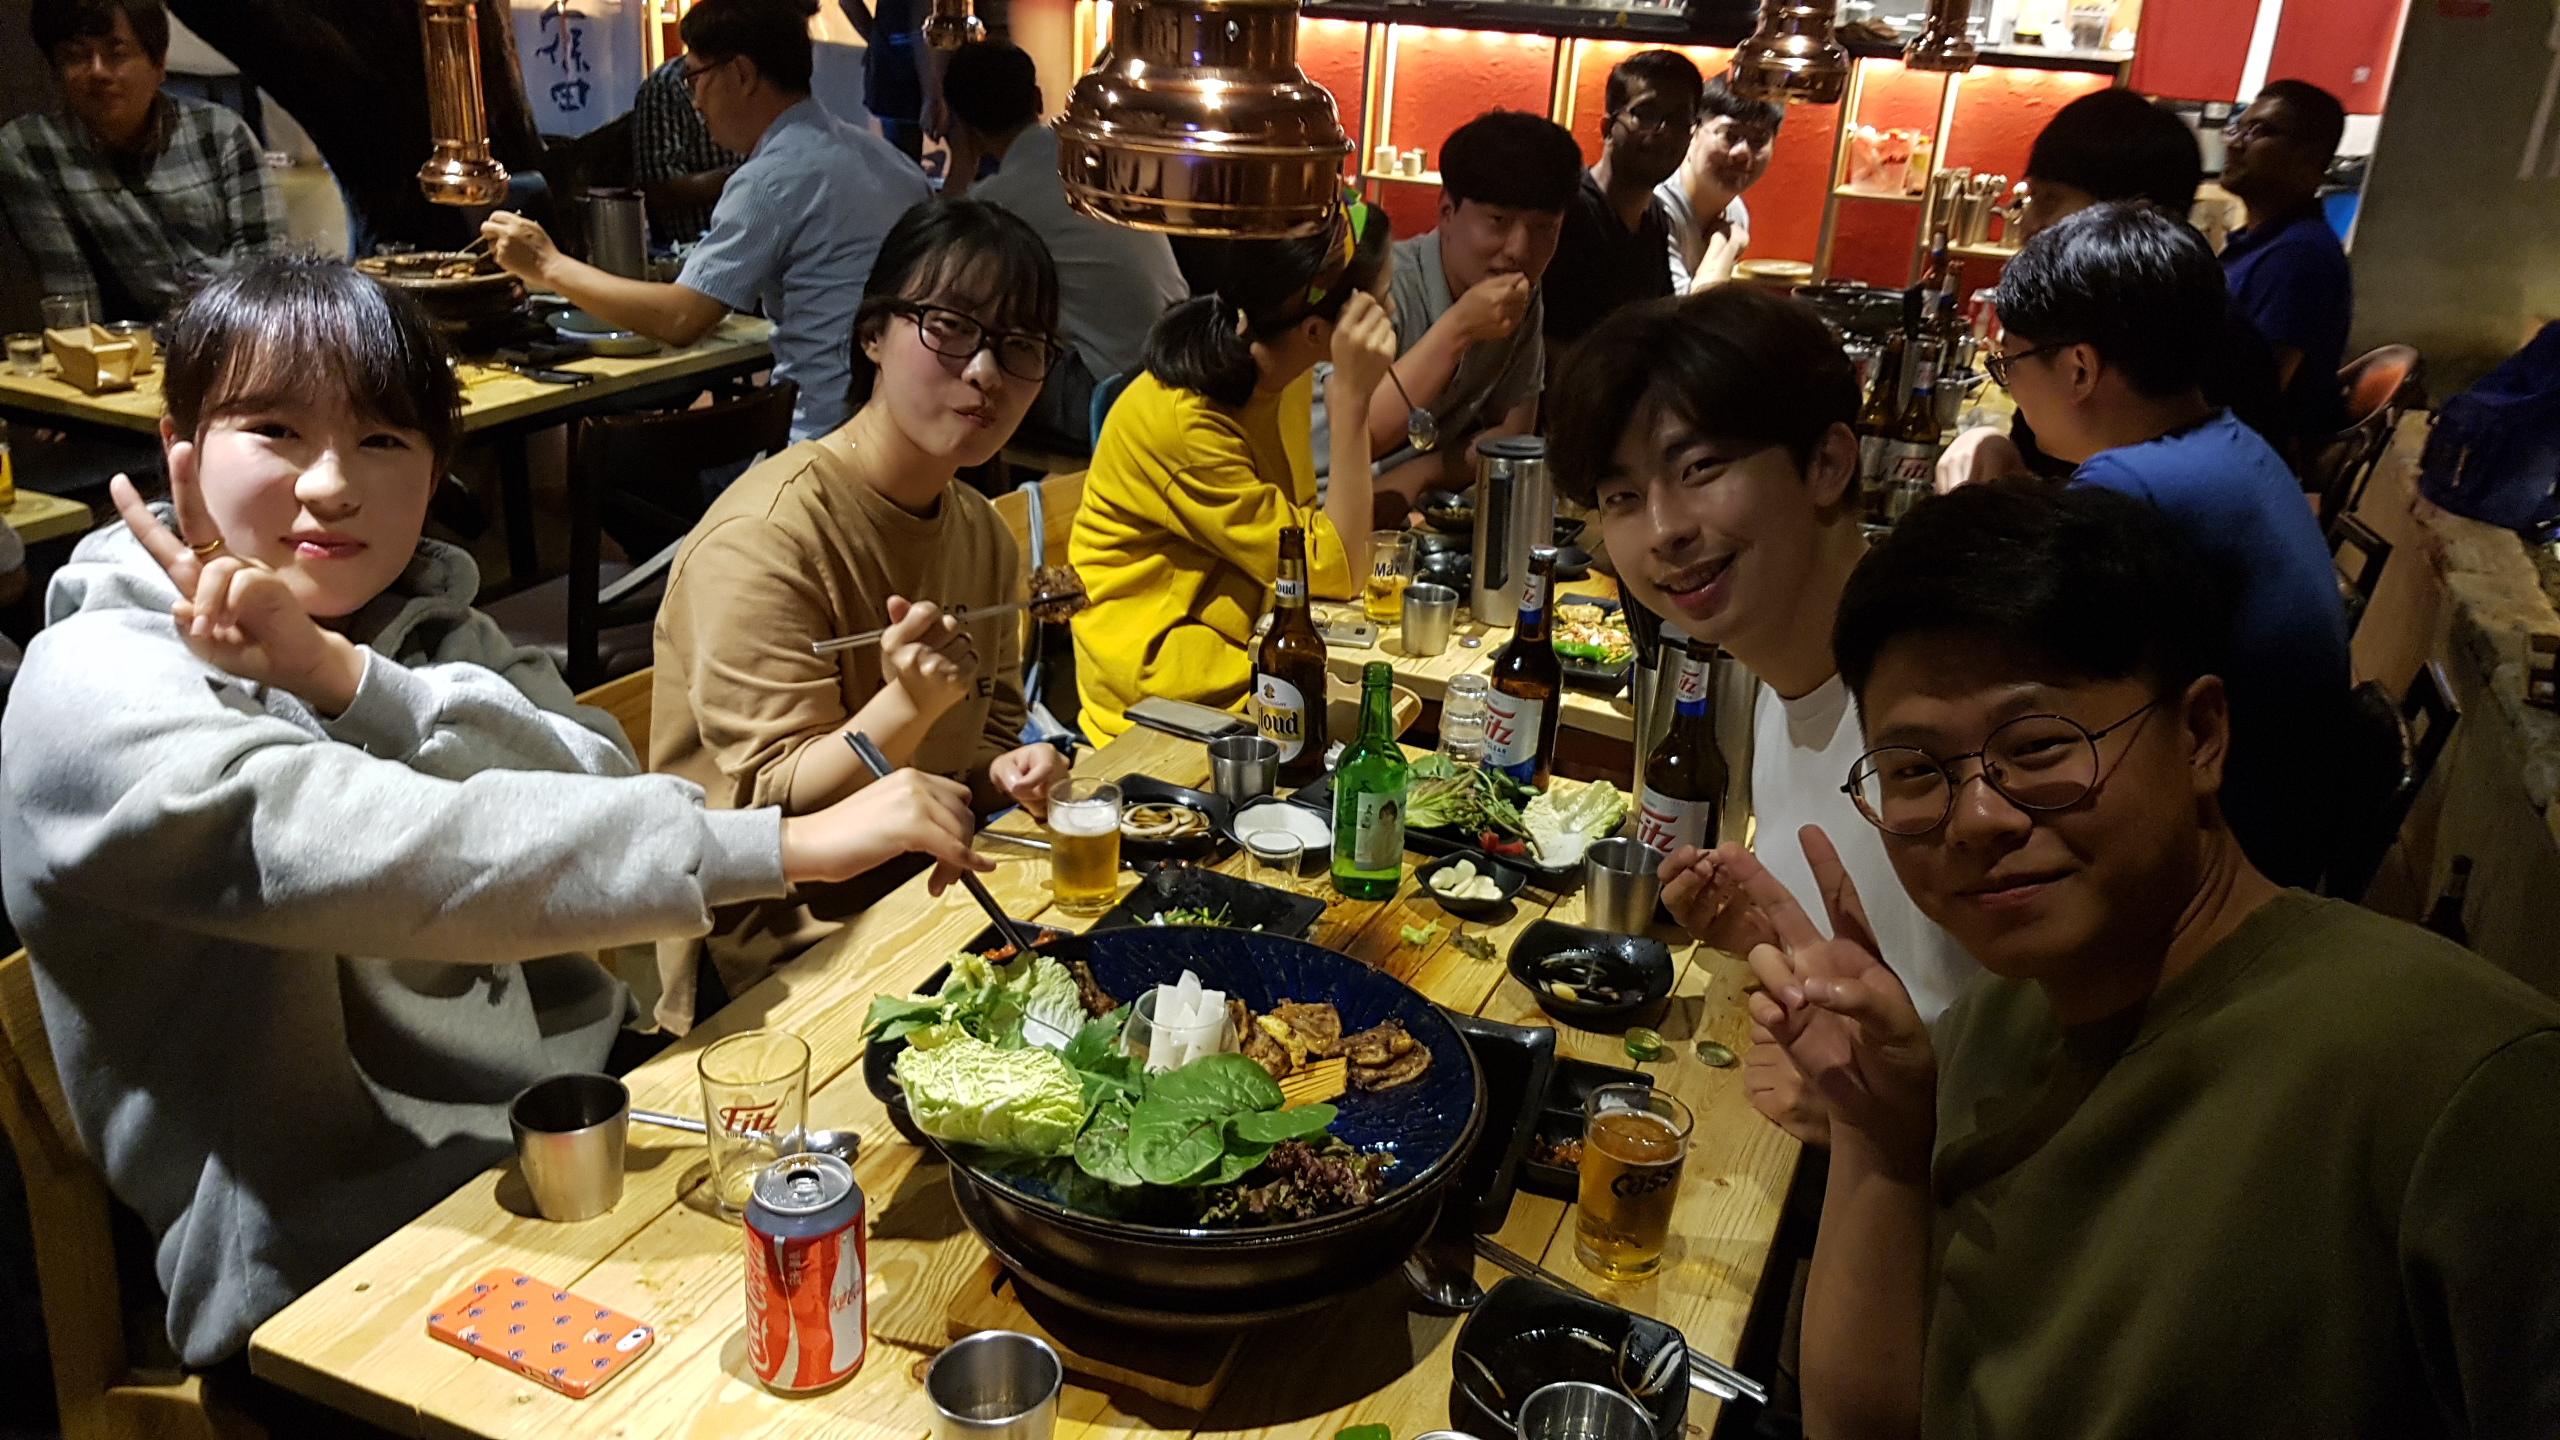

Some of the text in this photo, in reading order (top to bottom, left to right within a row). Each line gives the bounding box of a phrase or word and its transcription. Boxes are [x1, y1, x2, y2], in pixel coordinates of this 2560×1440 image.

[1276, 581, 1296, 595] loud
[1259, 707, 1299, 735] loud
[720, 1097, 778, 1133] Fitz
